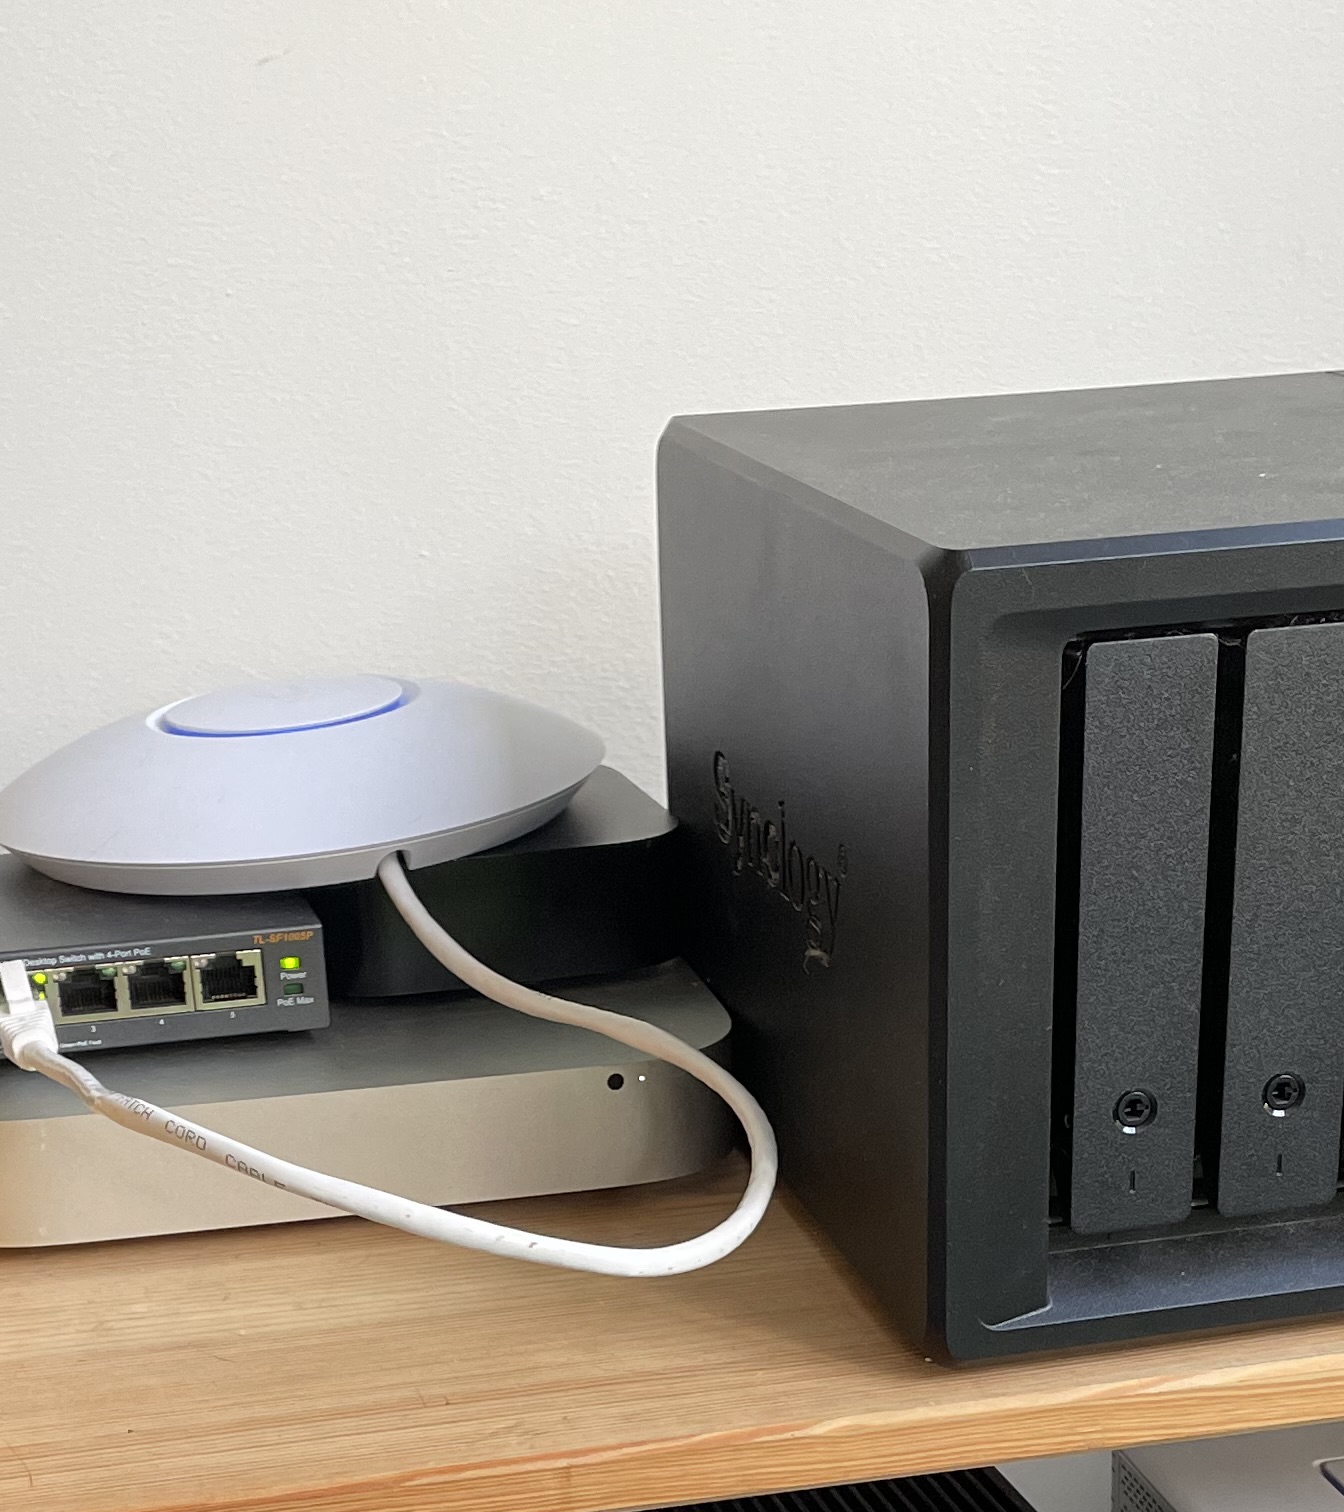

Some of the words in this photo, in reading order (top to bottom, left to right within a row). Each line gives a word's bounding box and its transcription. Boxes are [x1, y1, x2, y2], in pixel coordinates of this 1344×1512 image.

[24, 956, 57, 967] Desktop
[59, 953, 87, 965] Switch
[88, 951, 105, 961] with
[106, 949, 132, 959] 4-Port
[133, 947, 152, 957] PoE
[279, 971, 307, 981] Power
[277, 997, 295, 1007] PoE
[229, 1011, 236, 1019] 5
[90, 1025, 97, 1033] 3
[164, 1119, 207, 1151] CORD
